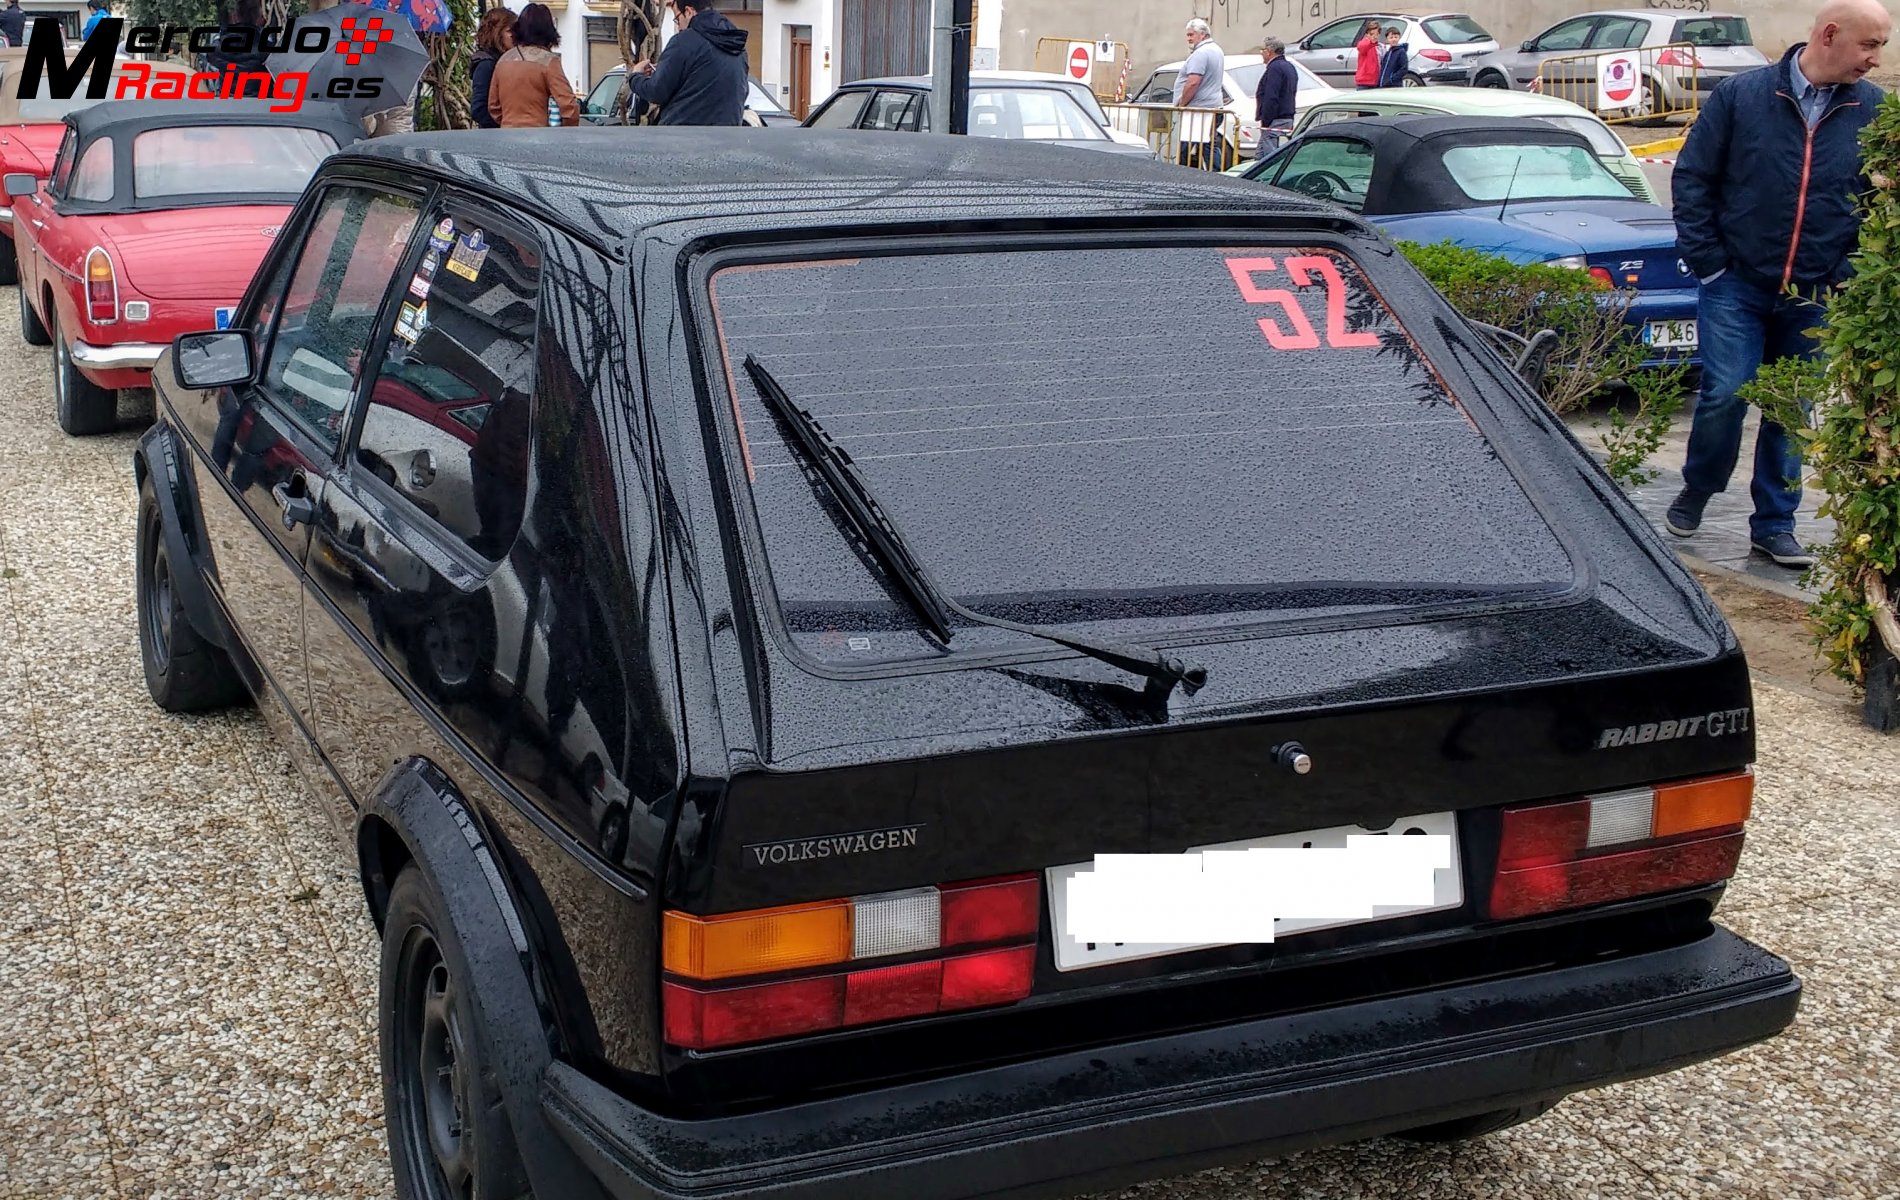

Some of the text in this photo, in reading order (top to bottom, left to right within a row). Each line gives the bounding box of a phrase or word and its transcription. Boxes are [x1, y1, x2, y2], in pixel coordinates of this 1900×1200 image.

[1225, 256, 1381, 350] 52
[1599, 707, 1750, 749] RABBIT GTI
[753, 828, 918, 866] VOLKSWAGEN
